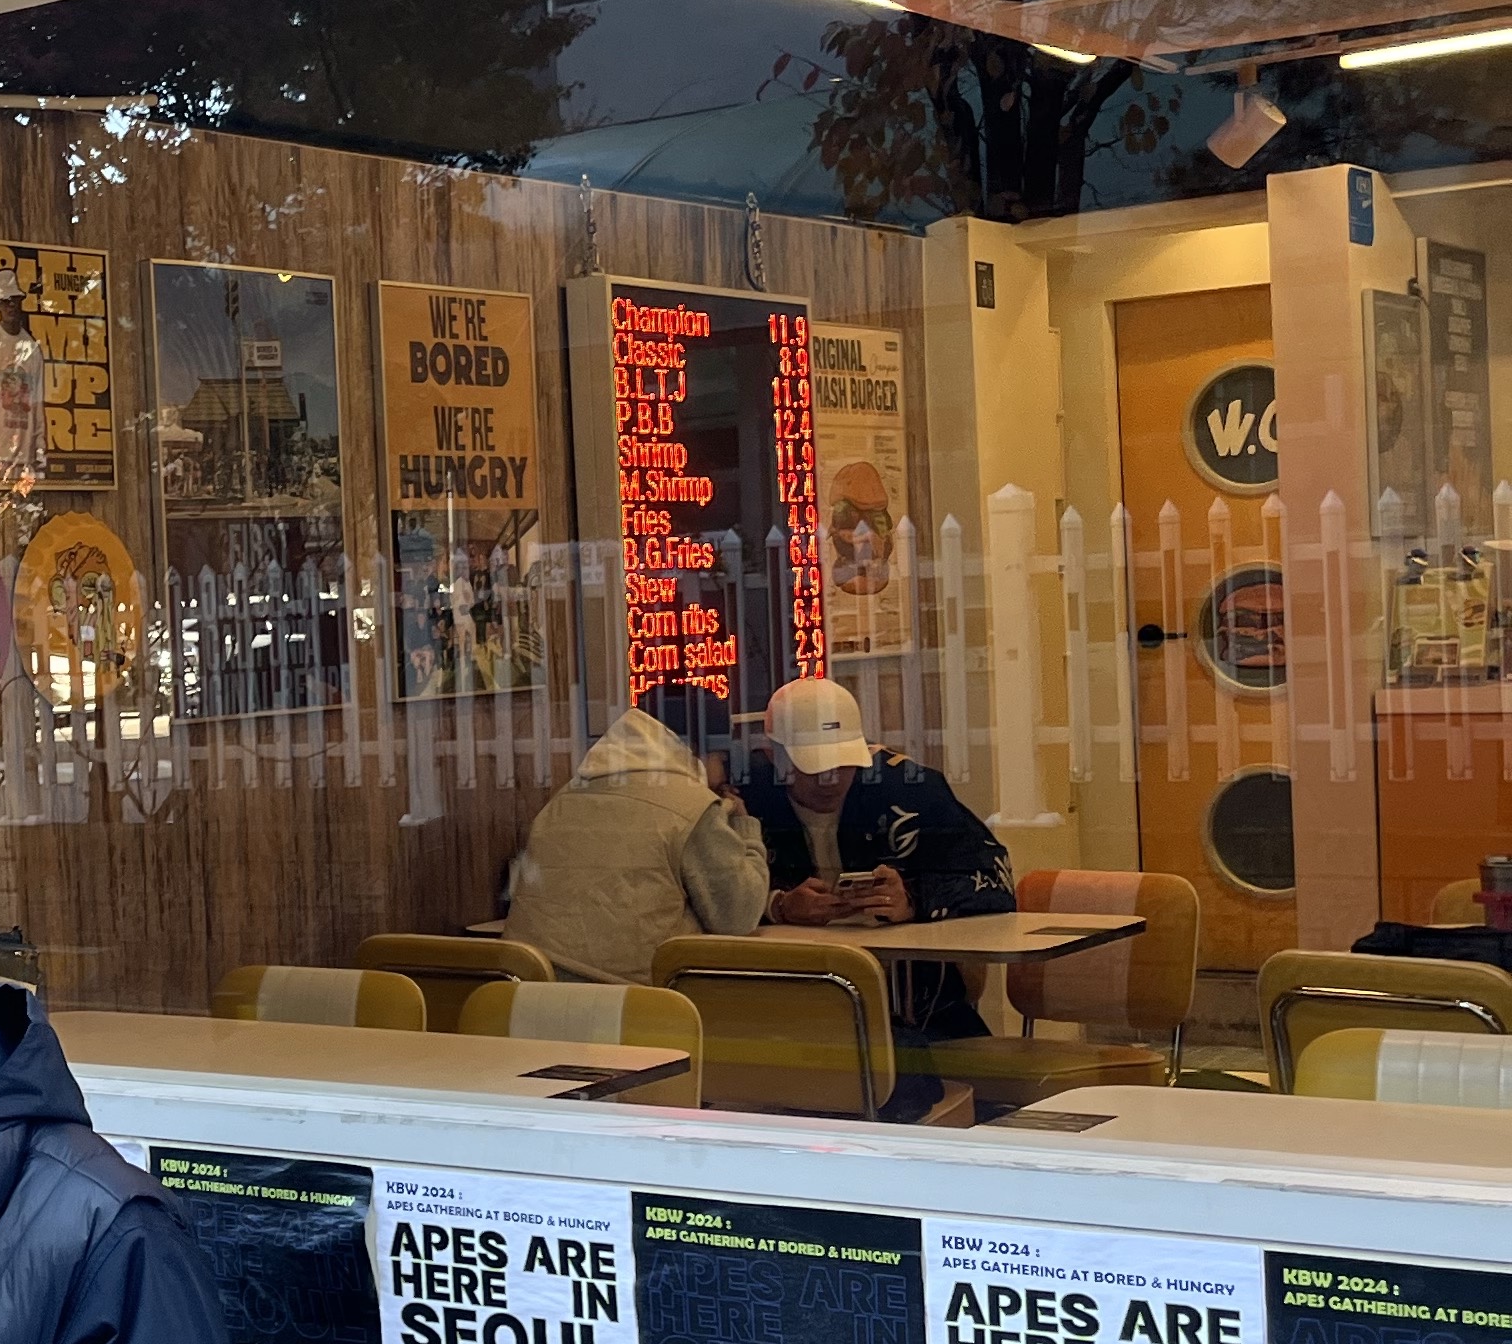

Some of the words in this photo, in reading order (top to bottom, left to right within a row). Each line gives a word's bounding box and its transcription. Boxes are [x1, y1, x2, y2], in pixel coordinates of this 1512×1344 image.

[53, 272, 93, 293] HUNG
[429, 295, 488, 341] WE'RE
[612, 297, 710, 342] Champion
[768, 313, 808, 346] 11.9
[409, 341, 509, 387] BORED
[613, 332, 686, 368] Classic
[779, 347, 809, 376] 8.9
[812, 336, 866, 372] RIGINAL
[772, 377, 810, 408] 11.9
[815, 375, 848, 409] MASH
[851, 377, 898, 412] BURGER
[433, 406, 495, 451] WE'RE
[615, 400, 674, 435] P.B.B
[774, 409, 812, 439] 12.4
[618, 435, 687, 471] Shrimp
[775, 441, 814, 471] 11.9
[399, 454, 528, 499] HUNGRY
[619, 469, 713, 506] M.Shrimp
[778, 472, 815, 502] 12.4
[622, 504, 672, 535] Fries
[788, 505, 818, 534] 4.9
[624, 537, 715, 570] B.G.Fries
[789, 535, 819, 565] 6.4
[626, 573, 678, 604] Stew
[792, 567, 820, 596] 7.9
[682, 604, 720, 635] ribs
[793, 598, 821, 628] 6.4
[684, 635, 736, 668] salad
[795, 629, 824, 660] 2.9
[160, 1159, 189, 1174] KBW
[191, 1162, 221, 1177] 2024
[386, 1181, 418, 1198] KBW
[422, 1185, 455, 1200] 2024
[387, 1200, 414, 1213] APES
[416, 1203, 483, 1219] GATHERING
[485, 1210, 500, 1222] AT
[503, 1211, 543, 1225] BORED
[558, 1216, 610, 1232] HUNGRY
[646, 1207, 683, 1225] KBW
[686, 1212, 722, 1230] 2024
[390, 1221, 509, 1269] APES
[524, 1236, 617, 1281] ARE
[646, 1227, 677, 1242] APES
[679, 1230, 755, 1250] GATHERING
[778, 1240, 825, 1258] BORED
[841, 1246, 900, 1265] HUNGRY
[941, 1235, 982, 1253] KBW
[988, 1241, 1030, 1258] 2024
[393, 1259, 507, 1308] HERE
[573, 1280, 618, 1322] IN
[648, 1250, 783, 1303] APES
[799, 1266, 908, 1318] ARE
[942, 1257, 977, 1272] APES
[980, 1259, 1067, 1282] GATHERING
[1070, 1269, 1089, 1283] AT
[1094, 1271, 1147, 1289] BORED
[1166, 1277, 1235, 1297] HUNGRY
[1283, 1268, 1332, 1288] KBW
[1337, 1275, 1388, 1295] 2024
[648, 1291, 783, 1344] HERE
[945, 1281, 1099, 1337] APES
